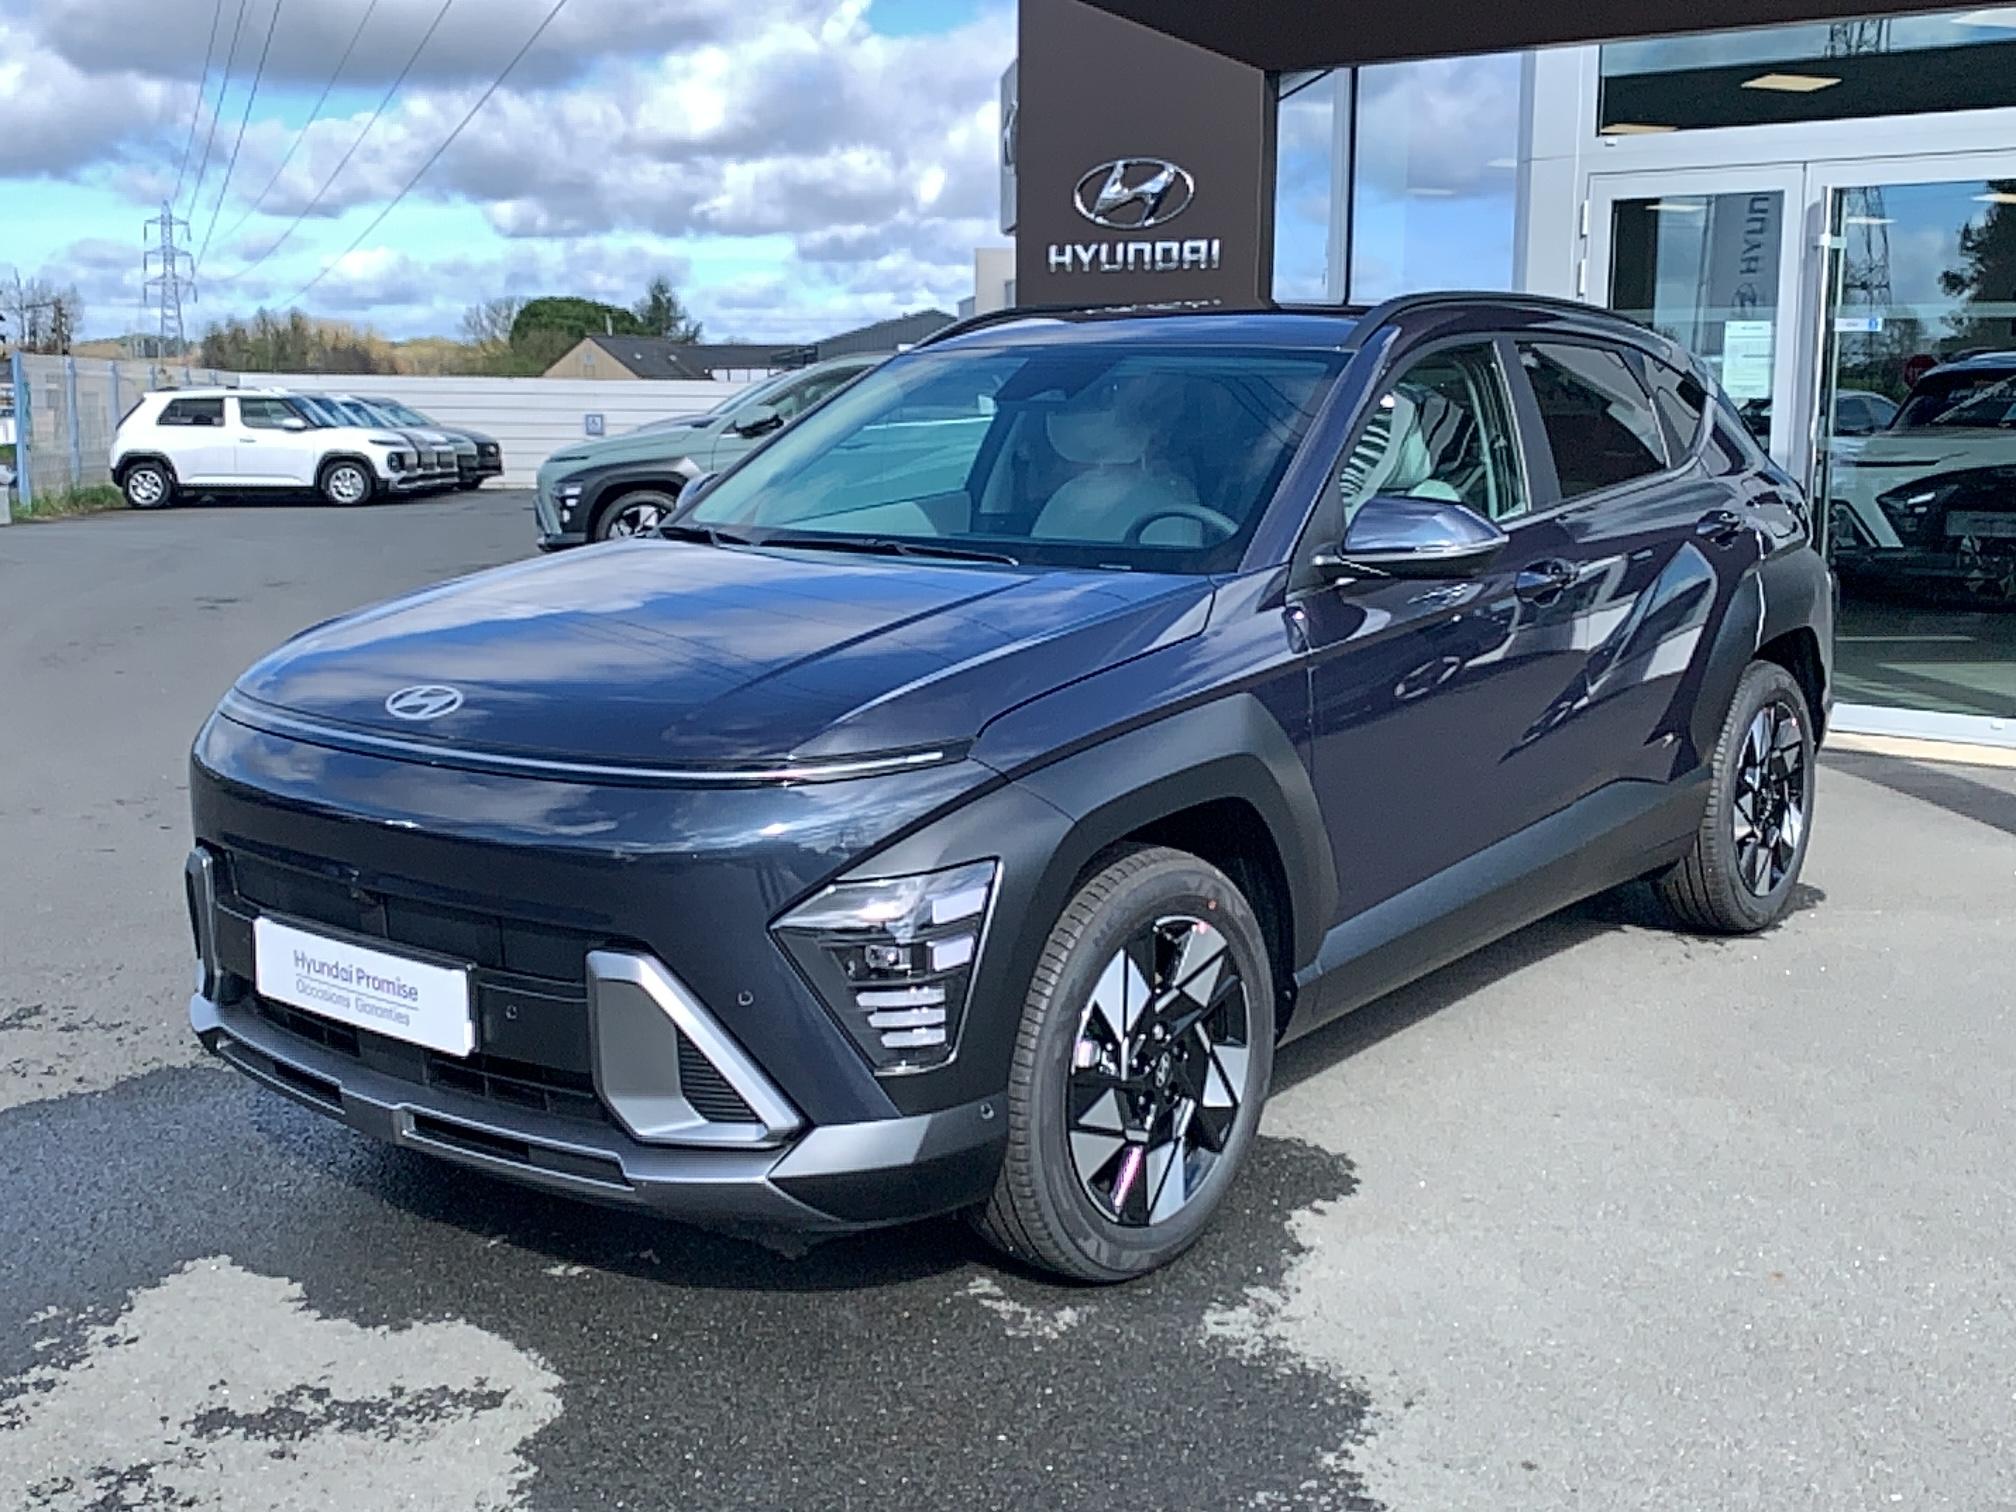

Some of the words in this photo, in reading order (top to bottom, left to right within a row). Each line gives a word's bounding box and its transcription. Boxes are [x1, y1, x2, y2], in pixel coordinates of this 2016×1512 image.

[1049, 239, 1221, 273] HYUNDAI
[294, 949, 353, 984] Hyundai
[356, 967, 418, 1002] Promise
